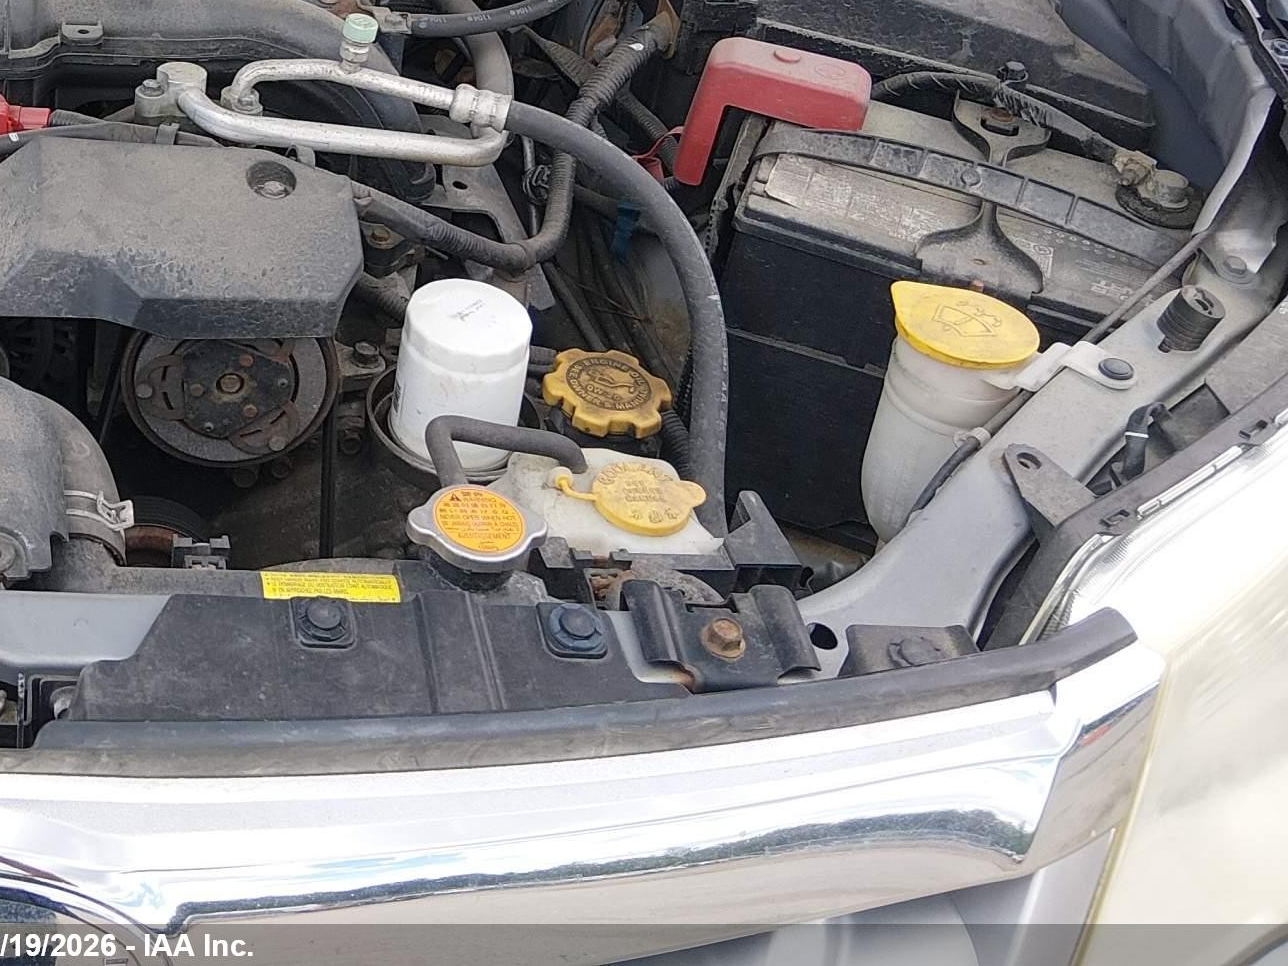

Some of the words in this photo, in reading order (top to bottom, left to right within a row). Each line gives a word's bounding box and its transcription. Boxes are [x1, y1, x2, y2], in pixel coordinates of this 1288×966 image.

[584, 357, 630, 372] ENGINE
[630, 371, 647, 386] OIL
[616, 386, 650, 410] MANUAL
